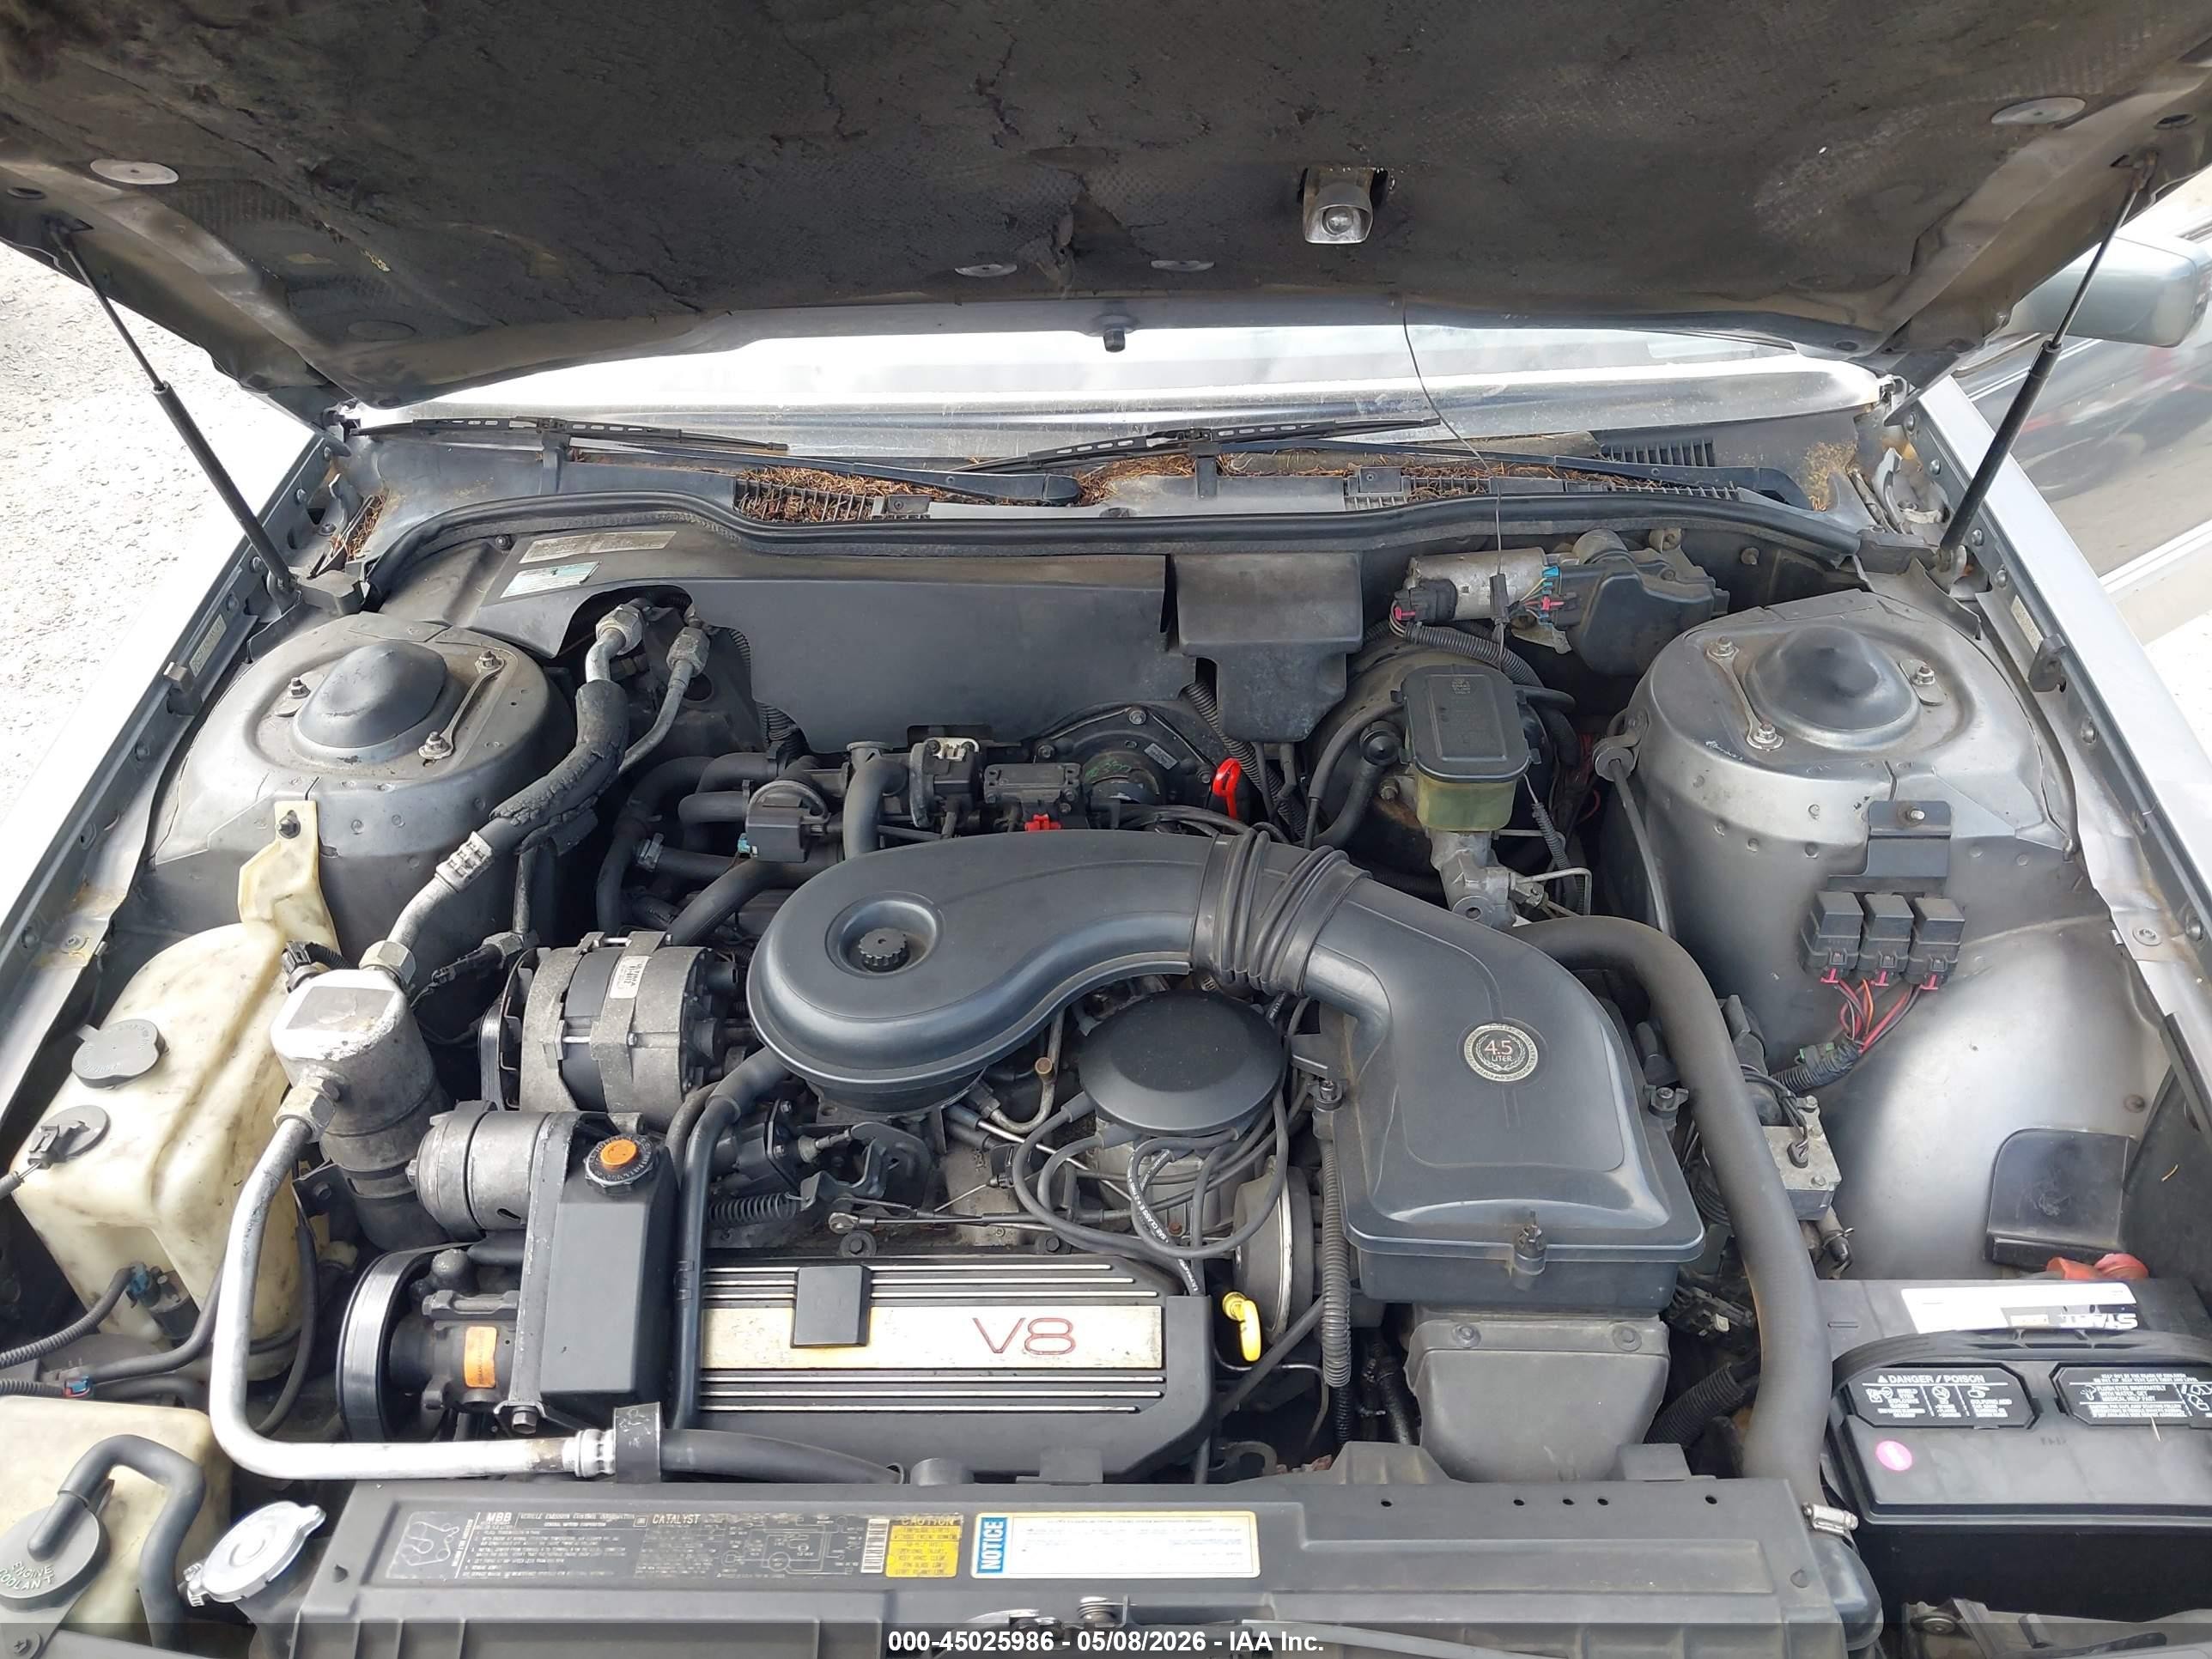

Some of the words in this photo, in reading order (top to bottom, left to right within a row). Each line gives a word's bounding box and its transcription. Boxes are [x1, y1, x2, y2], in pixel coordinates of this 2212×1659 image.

[1484, 1039, 1513, 1055] 4.5
[973, 1317, 1077, 1355] V8
[1888, 1375, 1934, 1383] DANGER
[1945, 1375, 1985, 1383] POISON
[652, 1514, 701, 1524] CATALYST
[902, 1516, 955, 1526] CAUTION
[981, 1521, 1006, 1571] NOTICE
[12, 1560, 54, 1578] ENGINE
